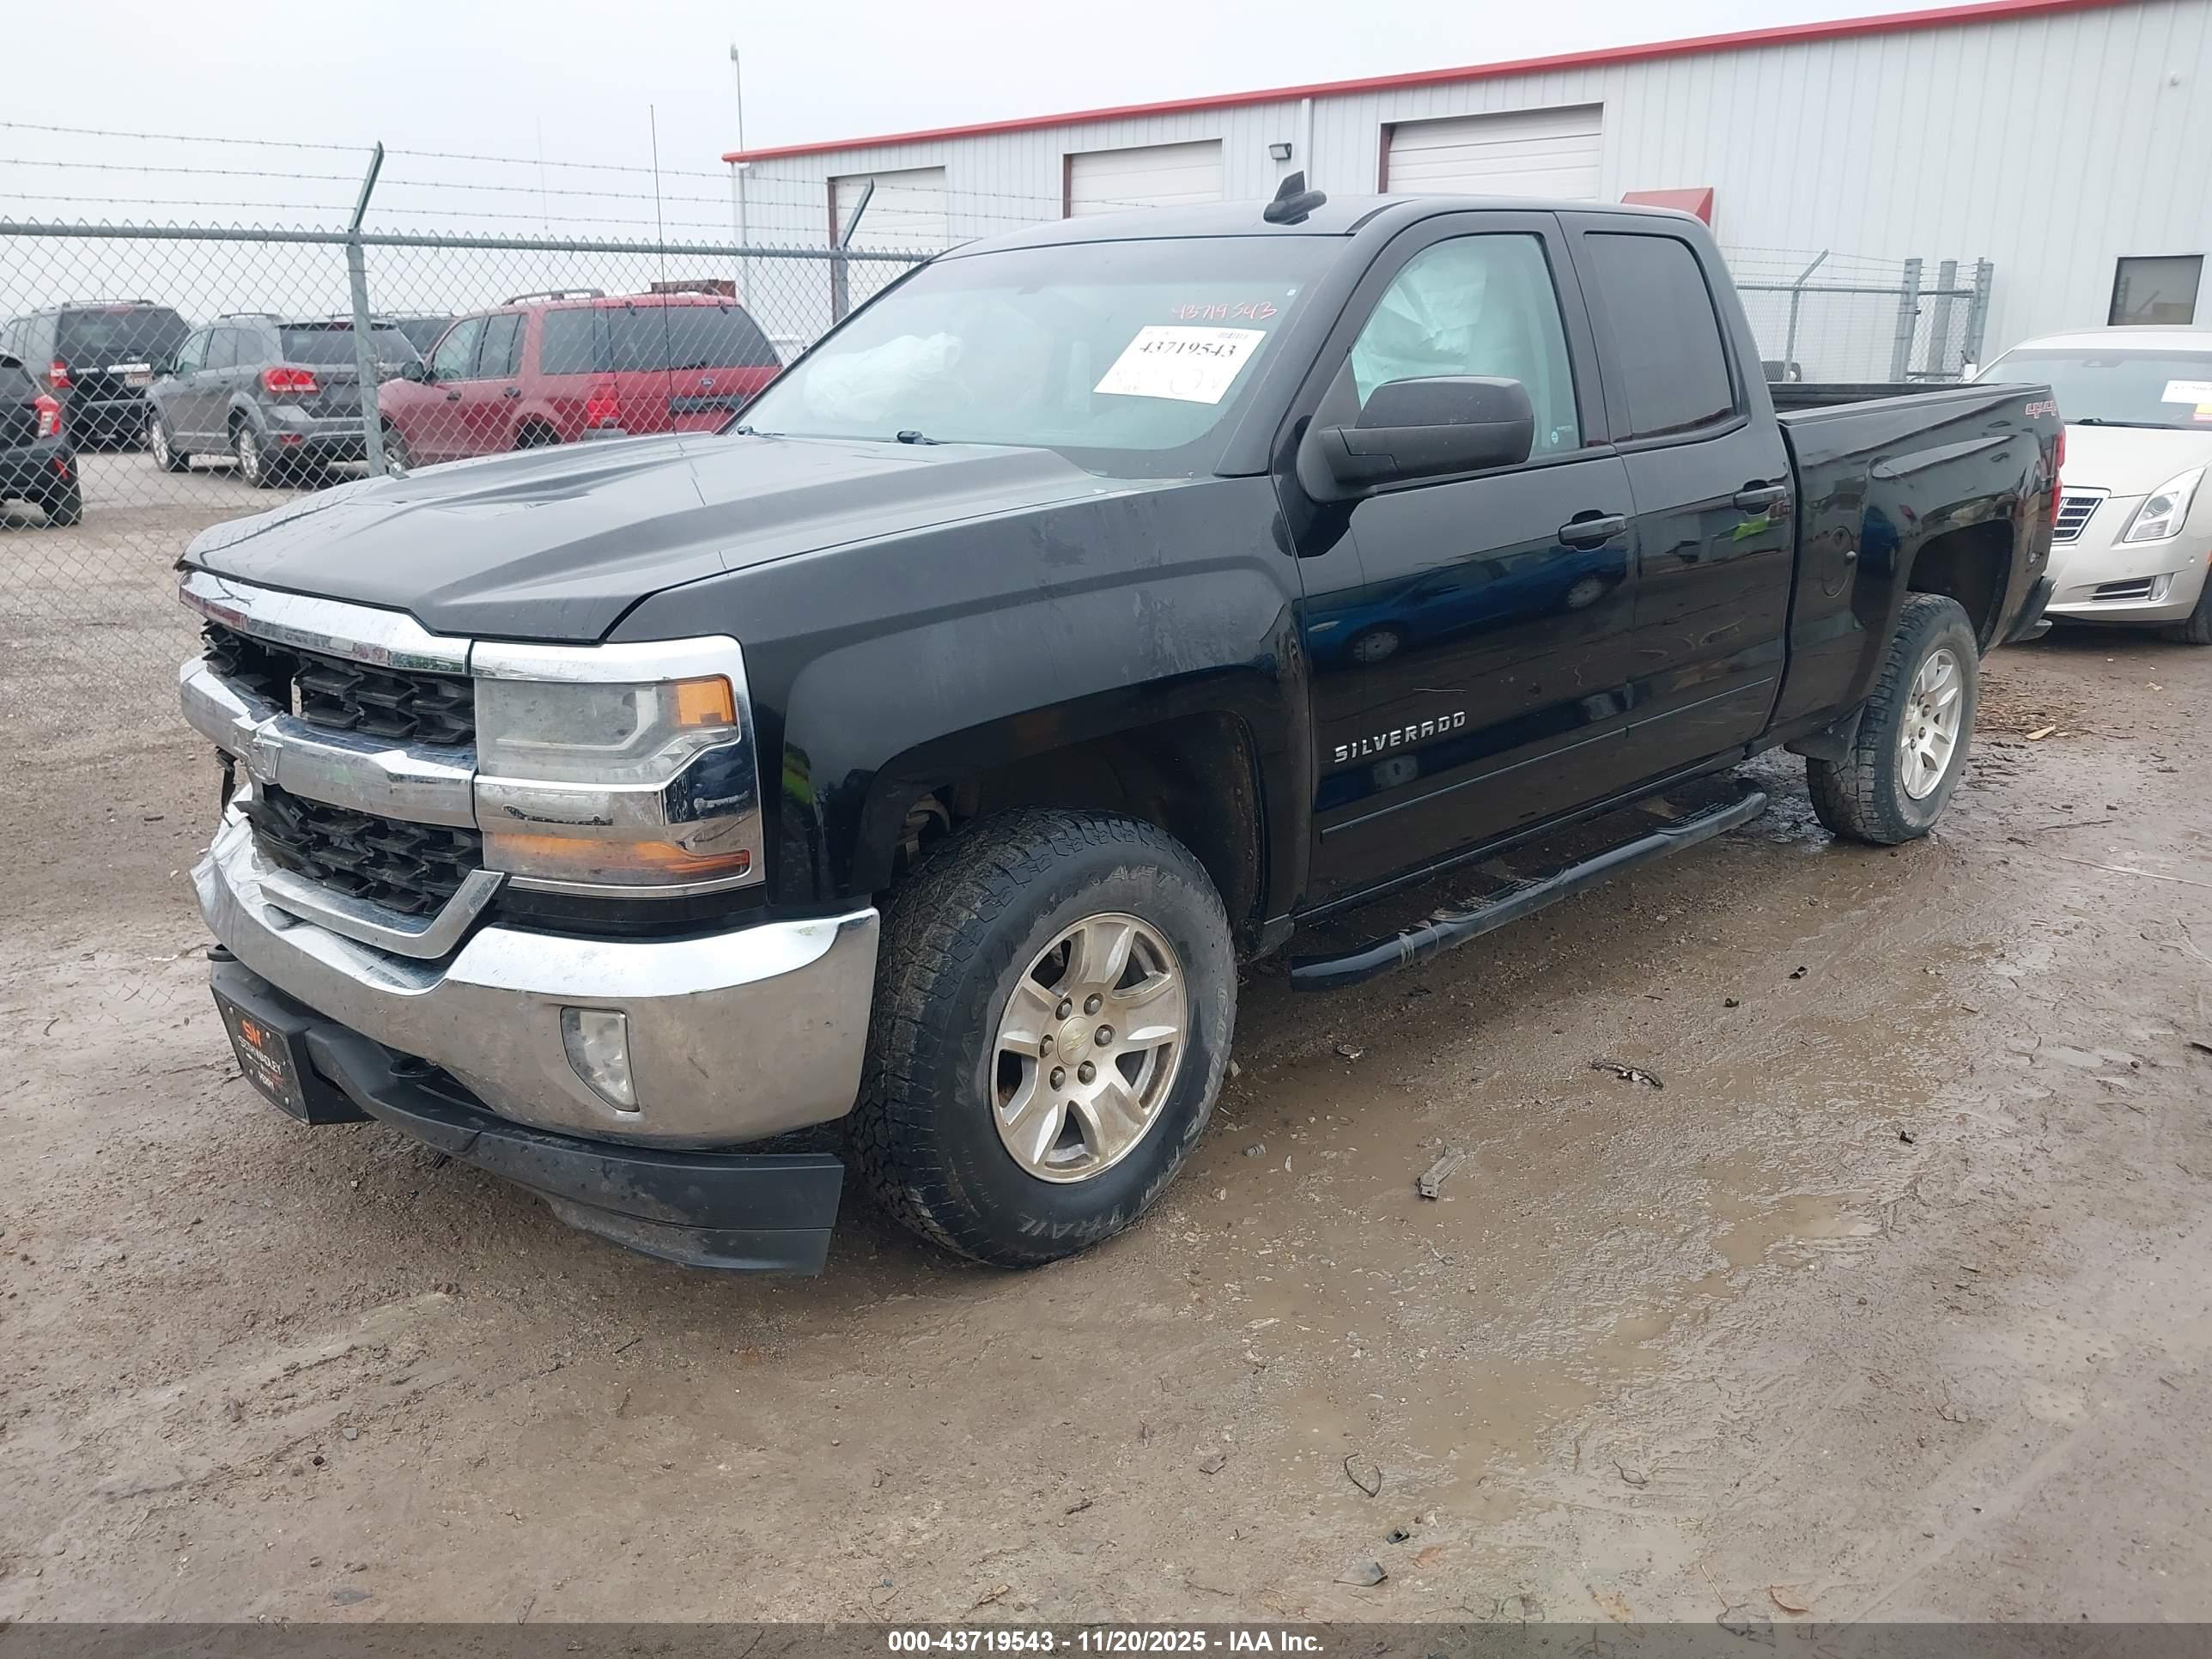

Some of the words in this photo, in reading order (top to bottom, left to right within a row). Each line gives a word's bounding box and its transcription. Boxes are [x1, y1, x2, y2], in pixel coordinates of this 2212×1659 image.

[1171, 301, 1278, 320] 43719543
[1139, 341, 1237, 358] 43719543
[1334, 711, 1466, 763] SILVERADO
